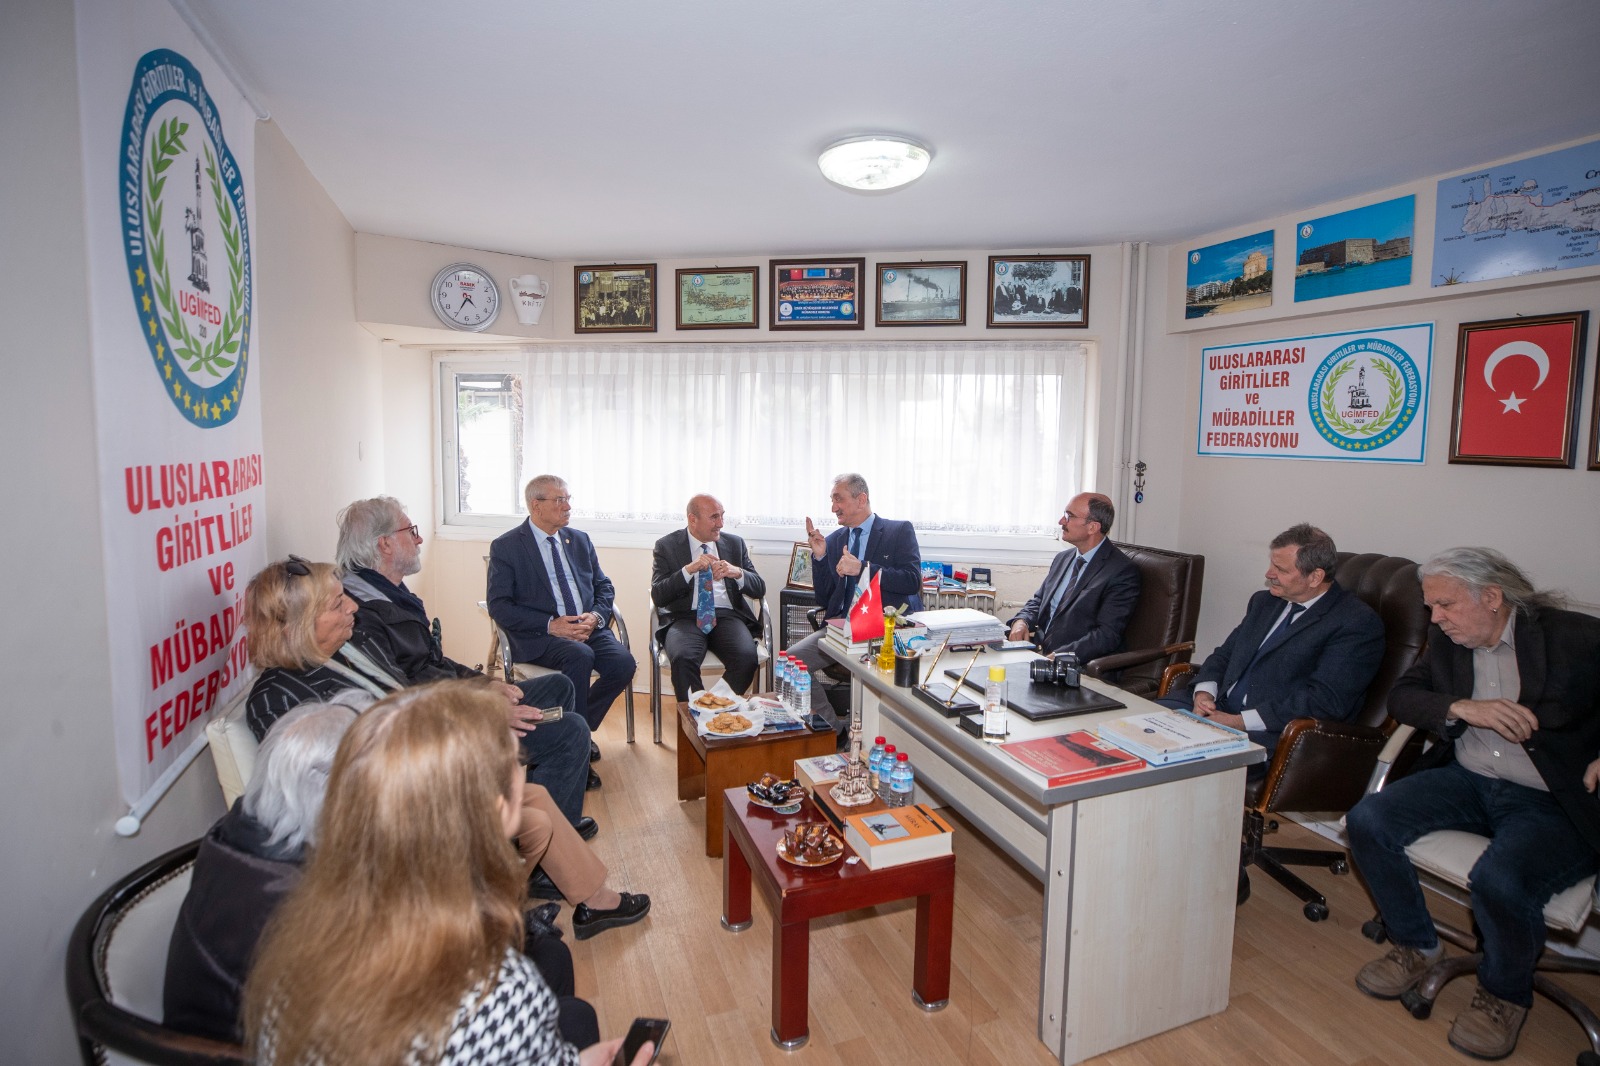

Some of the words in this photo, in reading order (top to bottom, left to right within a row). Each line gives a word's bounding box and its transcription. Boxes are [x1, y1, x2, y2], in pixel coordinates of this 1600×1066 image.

[1209, 347, 1306, 371] ULUSLARARASI
[1220, 368, 1290, 390] GİRİTLİLER
[1312, 365, 1329, 410] ULUSLARARASI
[1327, 345, 1356, 366] GİRİTLİLER
[1367, 341, 1404, 363] MÜBADİLLER
[1401, 361, 1417, 408] FEDERASYONU
[1245, 392, 1259, 405] ve
[1212, 407, 1295, 427] MÜBADİLLER
[1341, 409, 1379, 418] UGİMFED
[1207, 432, 1299, 449] FEDERASYONU
[124, 454, 262, 515] ULUSLARARASI
[208, 561, 235, 596] ve
